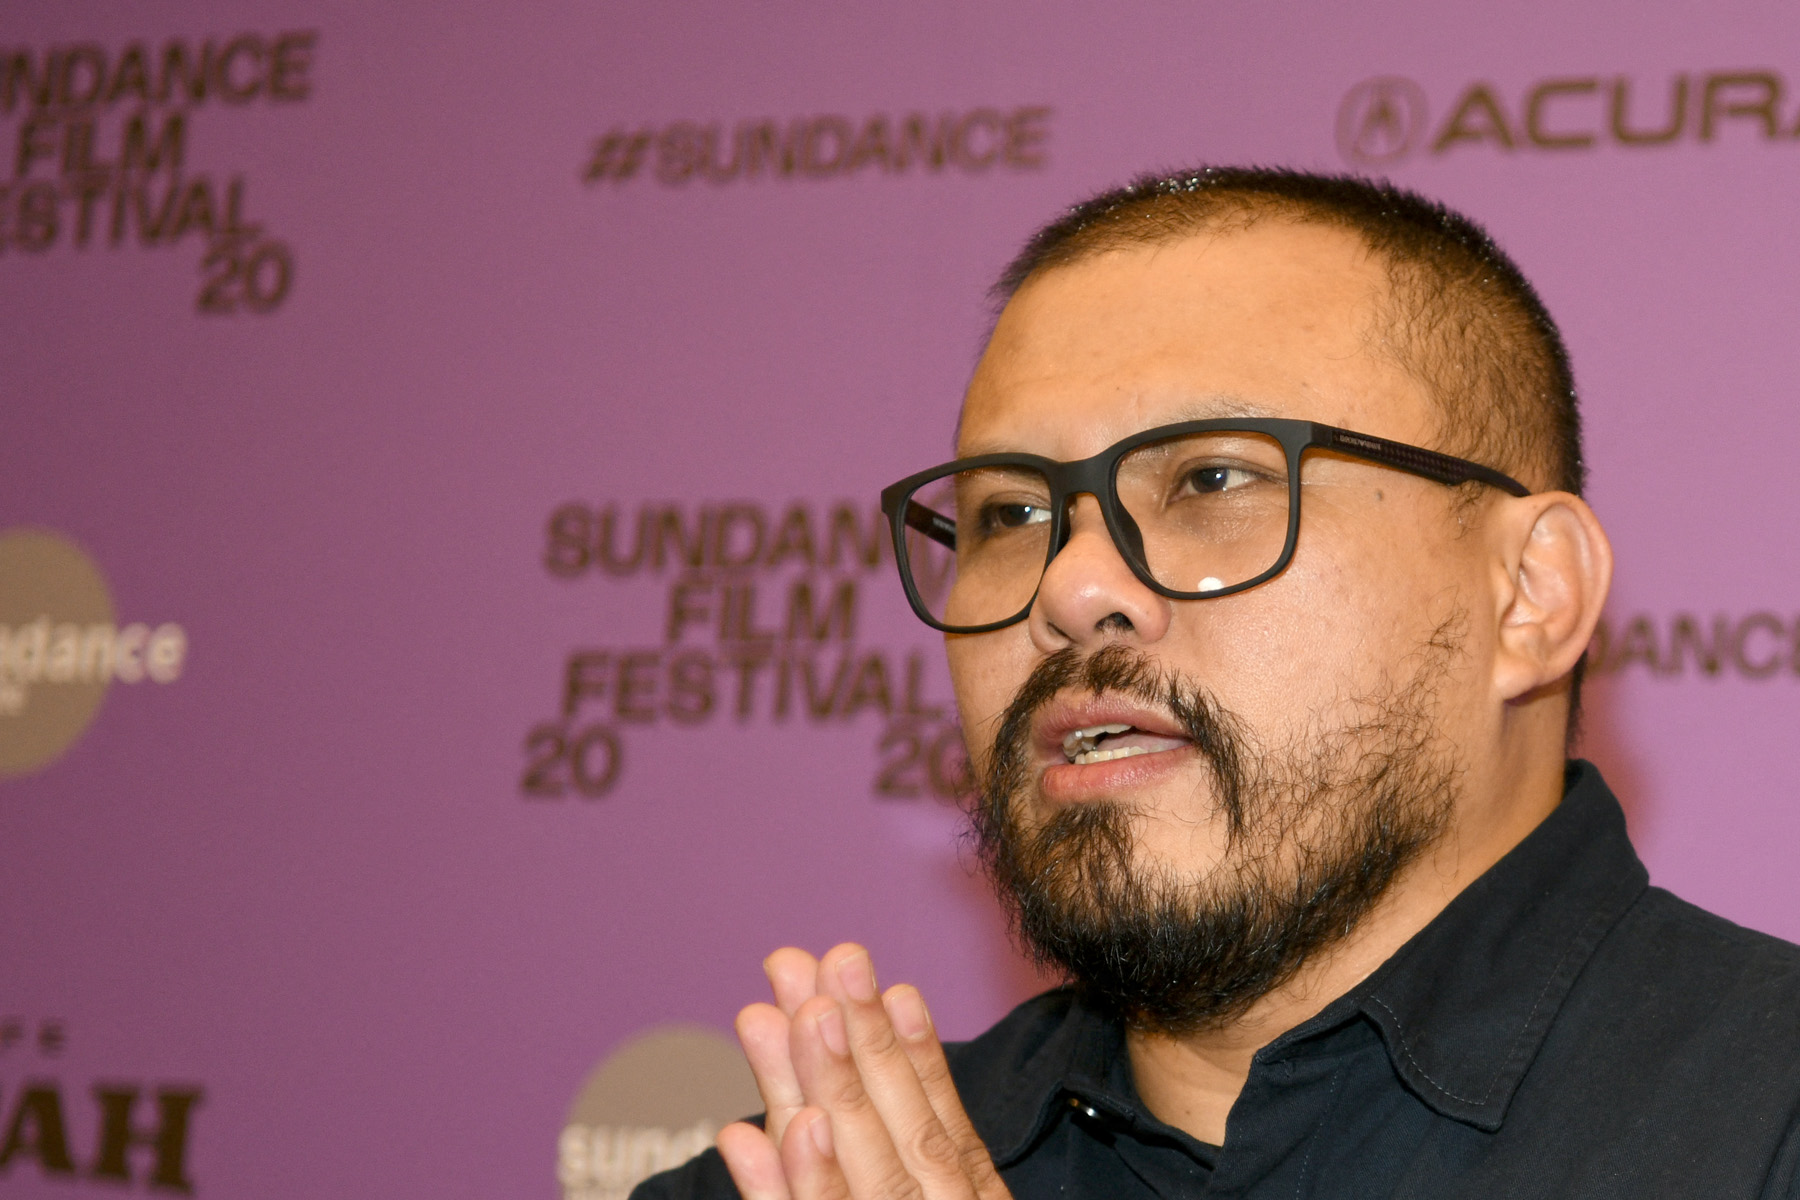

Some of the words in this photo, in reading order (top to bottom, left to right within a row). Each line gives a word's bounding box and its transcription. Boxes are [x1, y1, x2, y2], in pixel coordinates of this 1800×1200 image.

[16, 110, 186, 176] FILM
[581, 106, 1050, 187] #SUNDANCE
[0, 174, 262, 254] STIVAL
[198, 239, 293, 314] 20
[665, 574, 857, 645] FILM
[563, 648, 942, 727] FESTIVAL
[522, 723, 622, 800] 20
